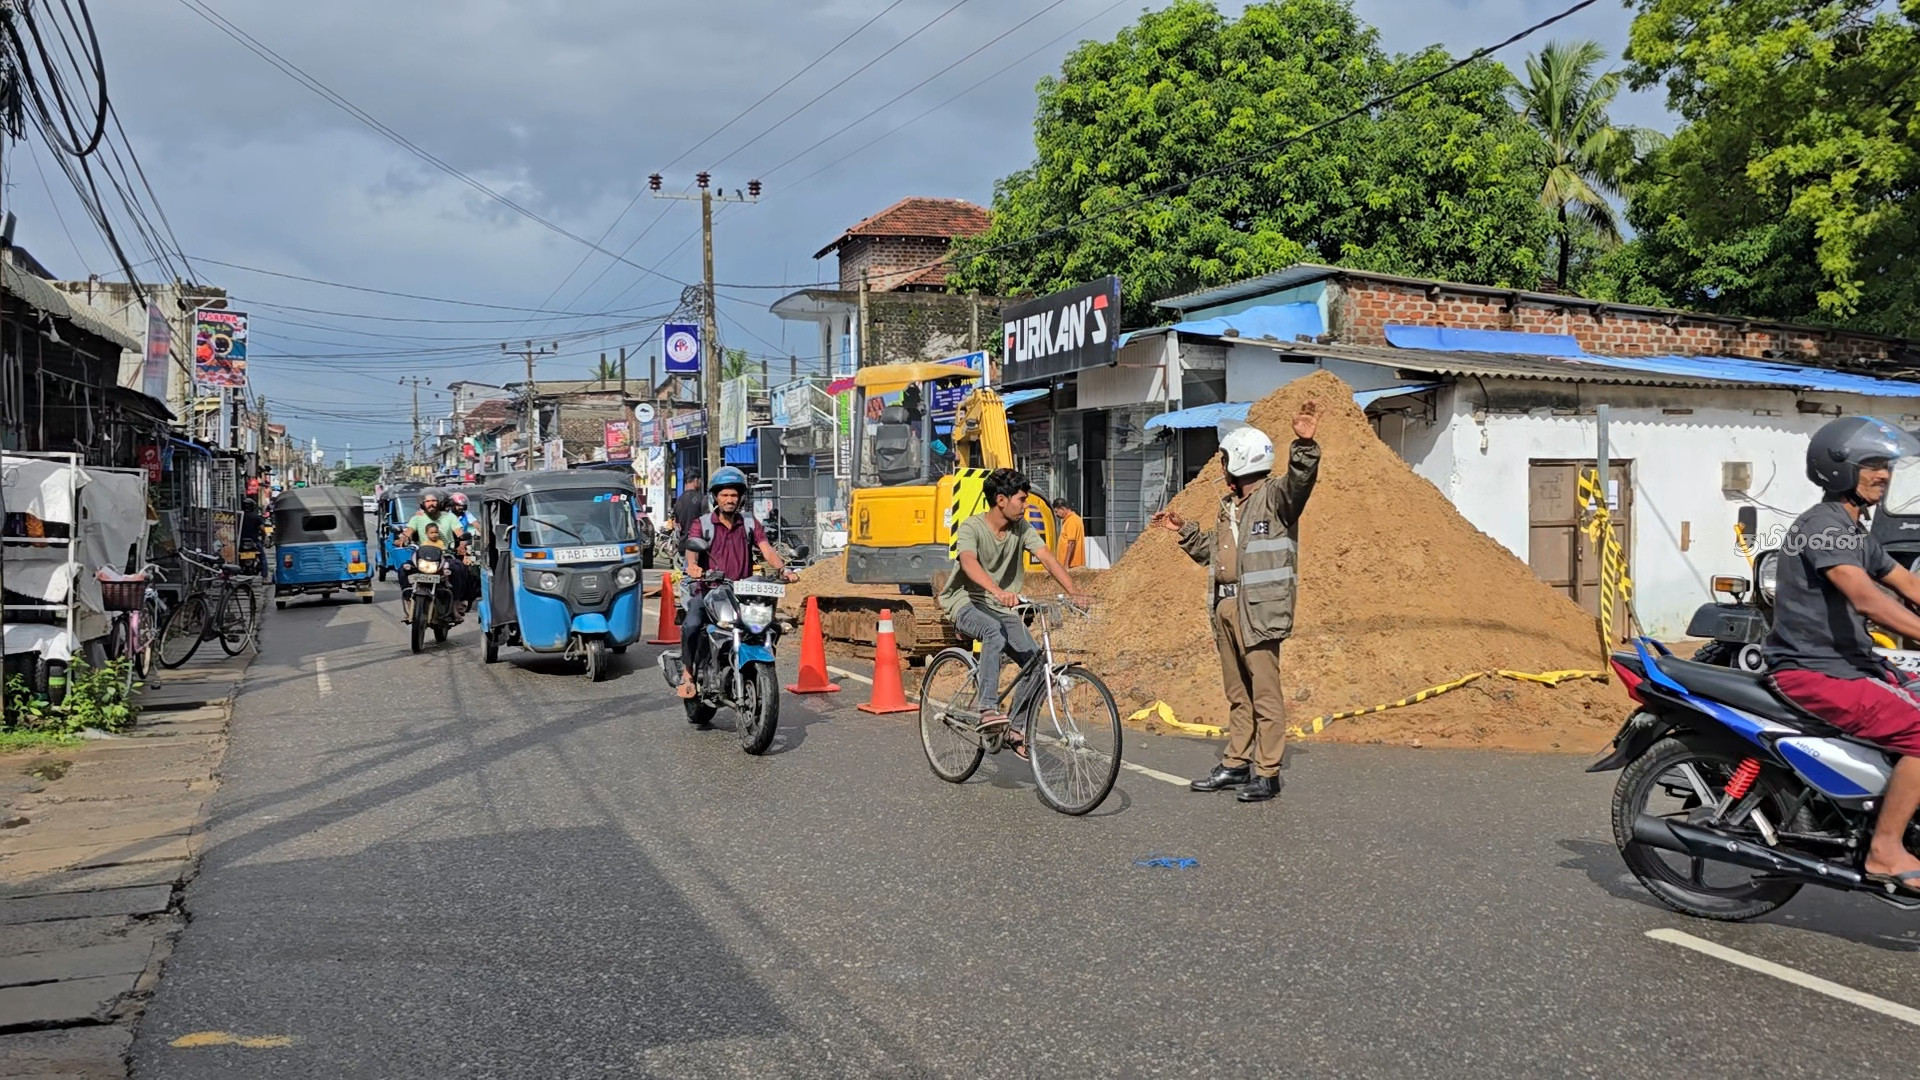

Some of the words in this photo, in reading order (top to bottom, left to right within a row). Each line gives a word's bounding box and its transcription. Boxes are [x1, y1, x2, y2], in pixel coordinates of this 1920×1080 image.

[1003, 294, 1109, 365] FURKAN'S
[840, 440, 851, 474] DIGITAL
[593, 547, 619, 558] 3120
